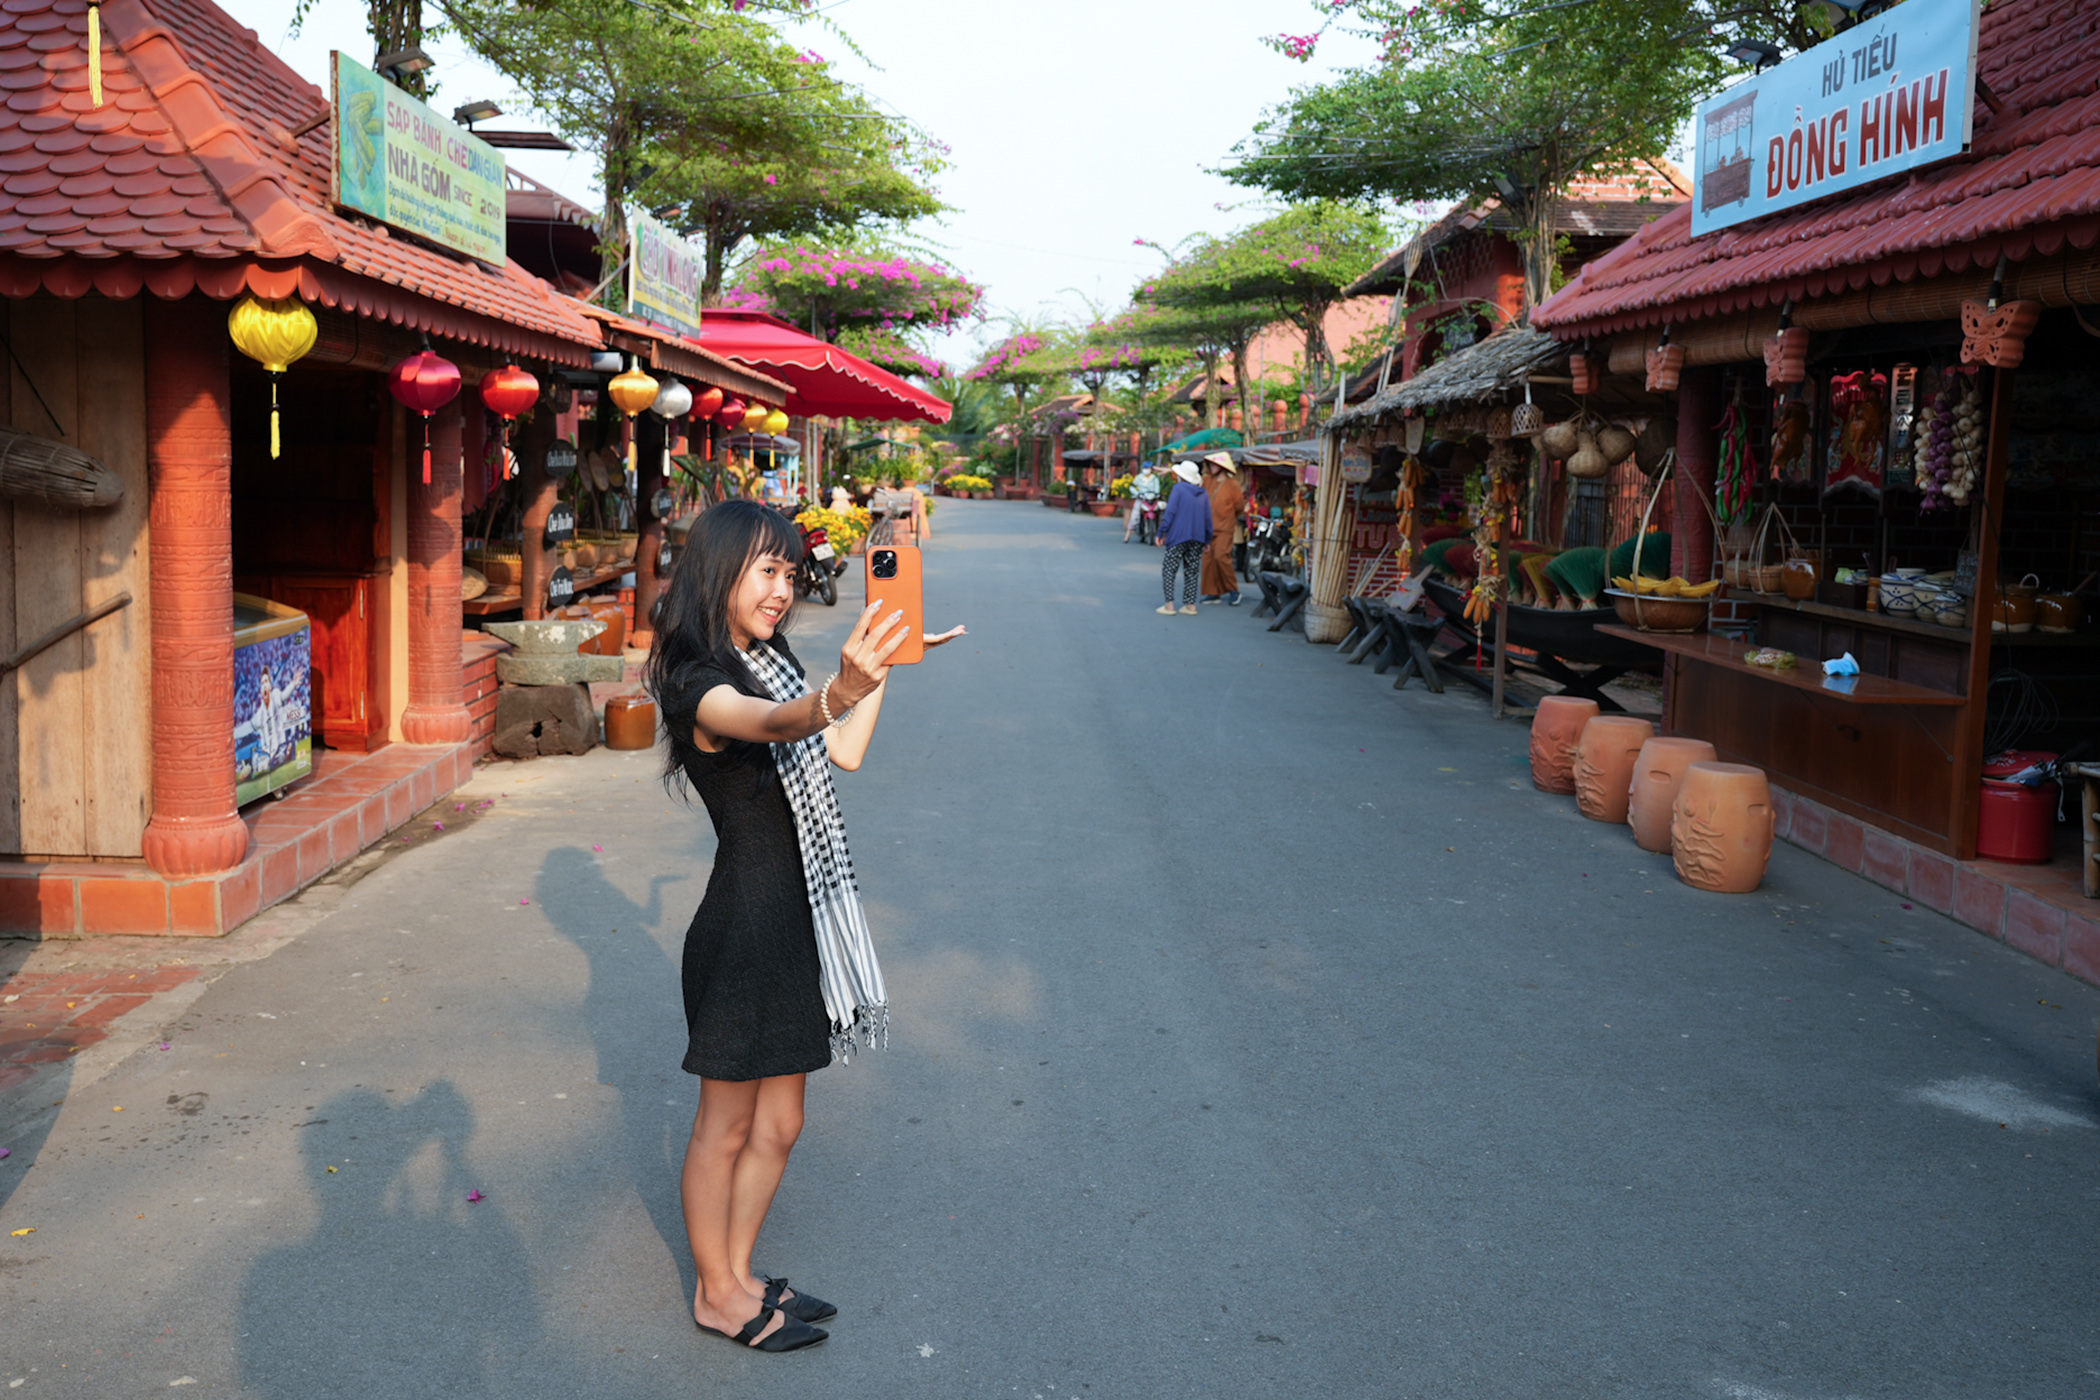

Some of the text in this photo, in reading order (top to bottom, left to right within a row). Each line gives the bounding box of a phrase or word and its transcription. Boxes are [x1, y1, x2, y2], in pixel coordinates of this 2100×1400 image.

[1822, 24, 1898, 98] HỦ TIẾU
[387, 100, 410, 134] SẠP
[413, 116, 442, 155] BÁNH
[447, 137, 468, 170] CHÈ
[1766, 69, 1949, 200] ĐỒNG HÍNH
[388, 142, 501, 220] NHÀ GỐM SINCE 2019
